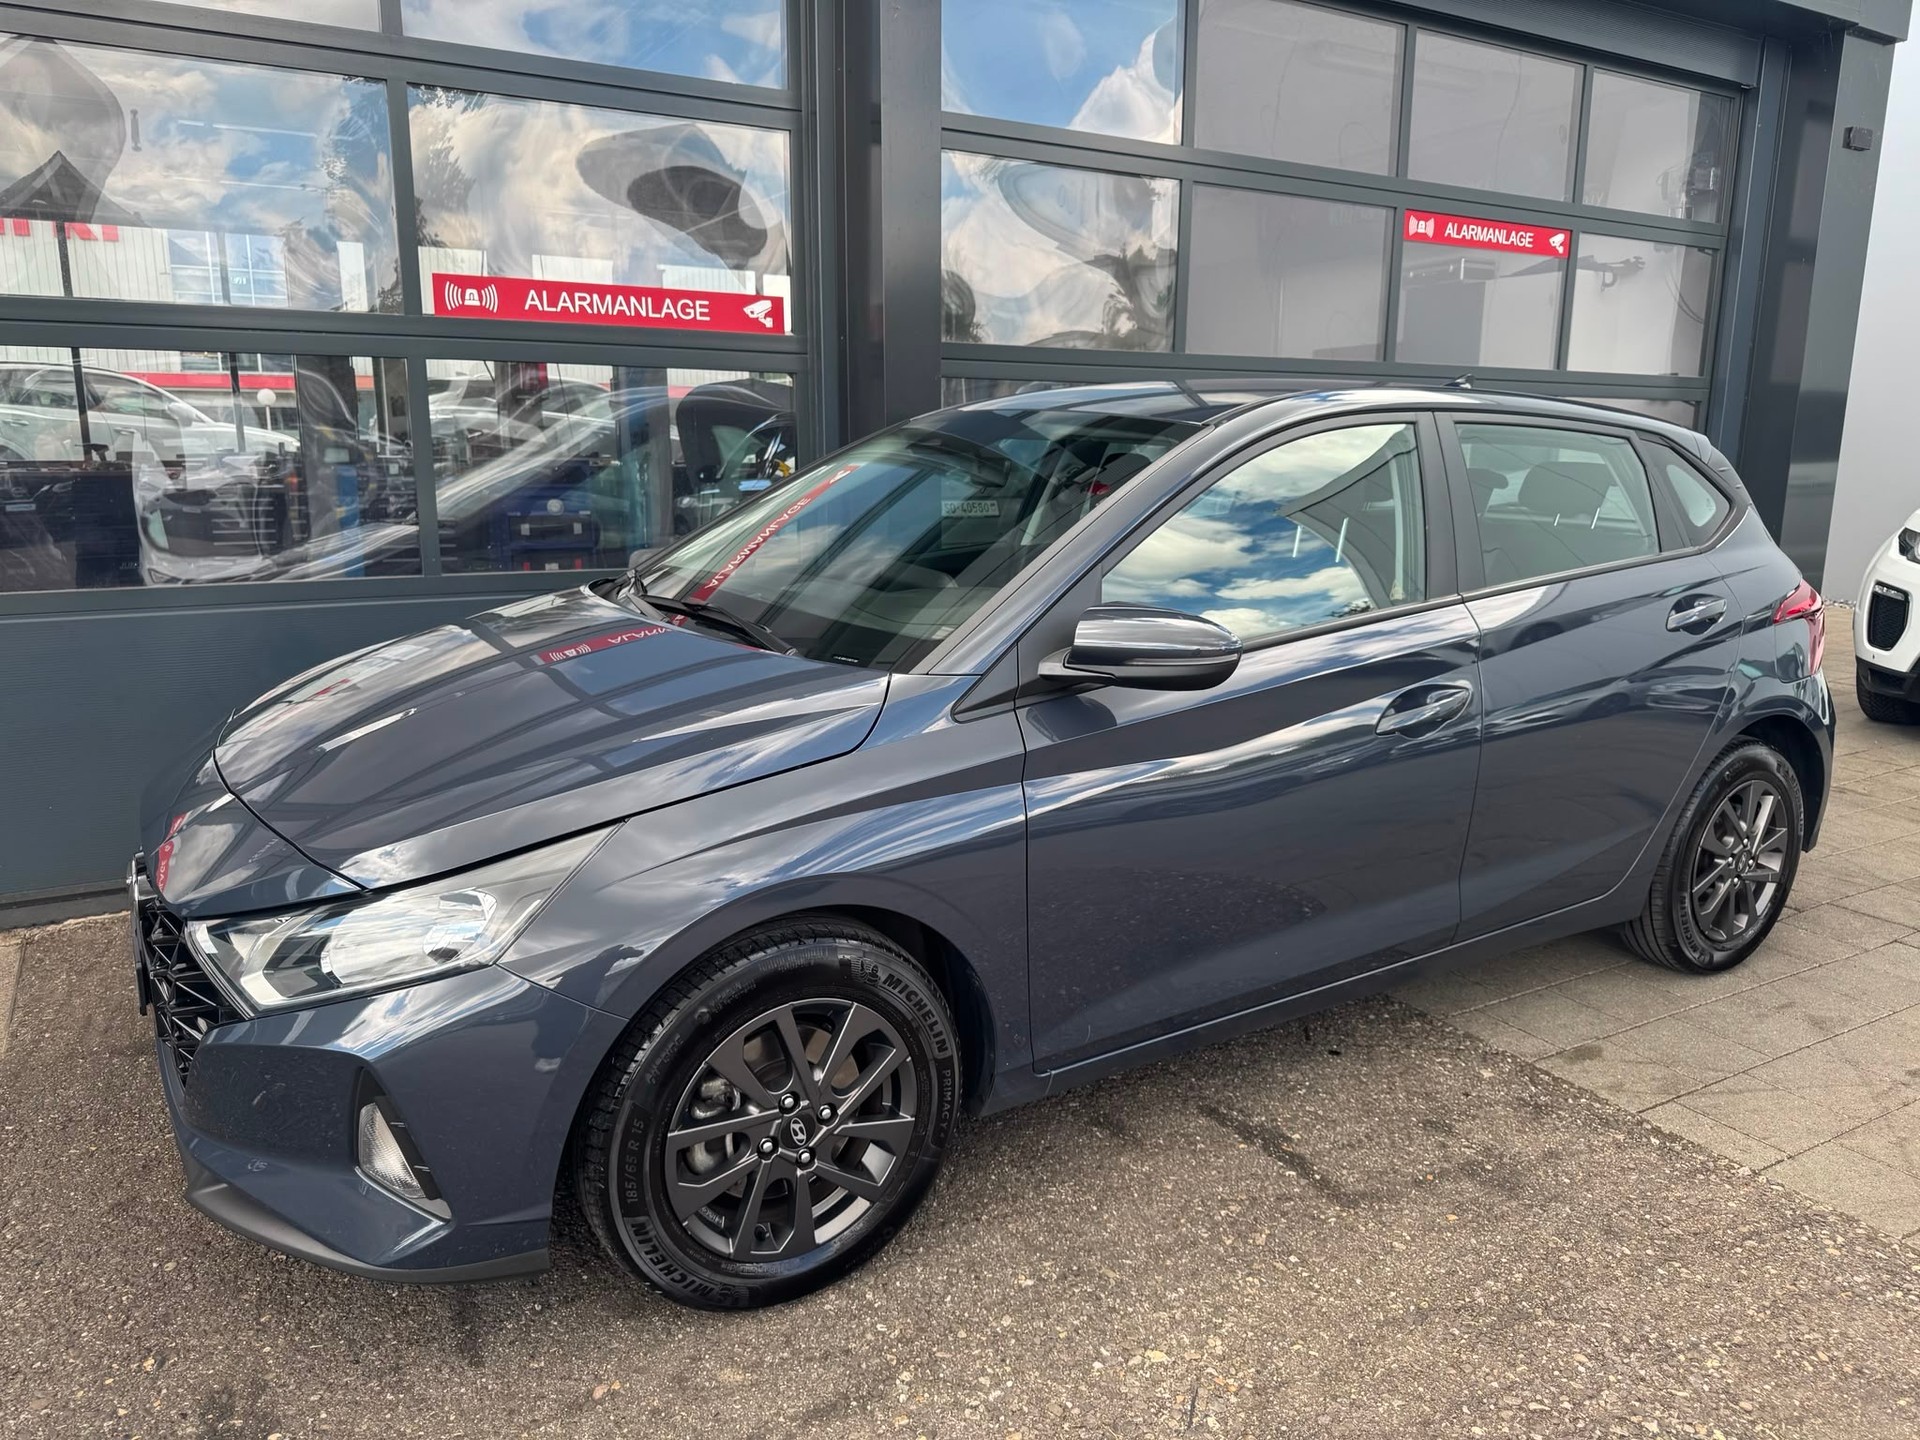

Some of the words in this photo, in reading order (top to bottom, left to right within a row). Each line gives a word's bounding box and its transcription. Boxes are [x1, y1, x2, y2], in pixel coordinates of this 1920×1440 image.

[1444, 222, 1534, 248] ALARMANLAGE
[524, 289, 711, 321] ALARMANLAGE
[882, 972, 949, 1054] MICHELIN
[941, 1069, 952, 1130] PRIMACY
[630, 1117, 645, 1135] 15
[627, 1139, 640, 1151] R
[624, 1154, 639, 1204] 185/65
[631, 1221, 719, 1297] MICHELIN
